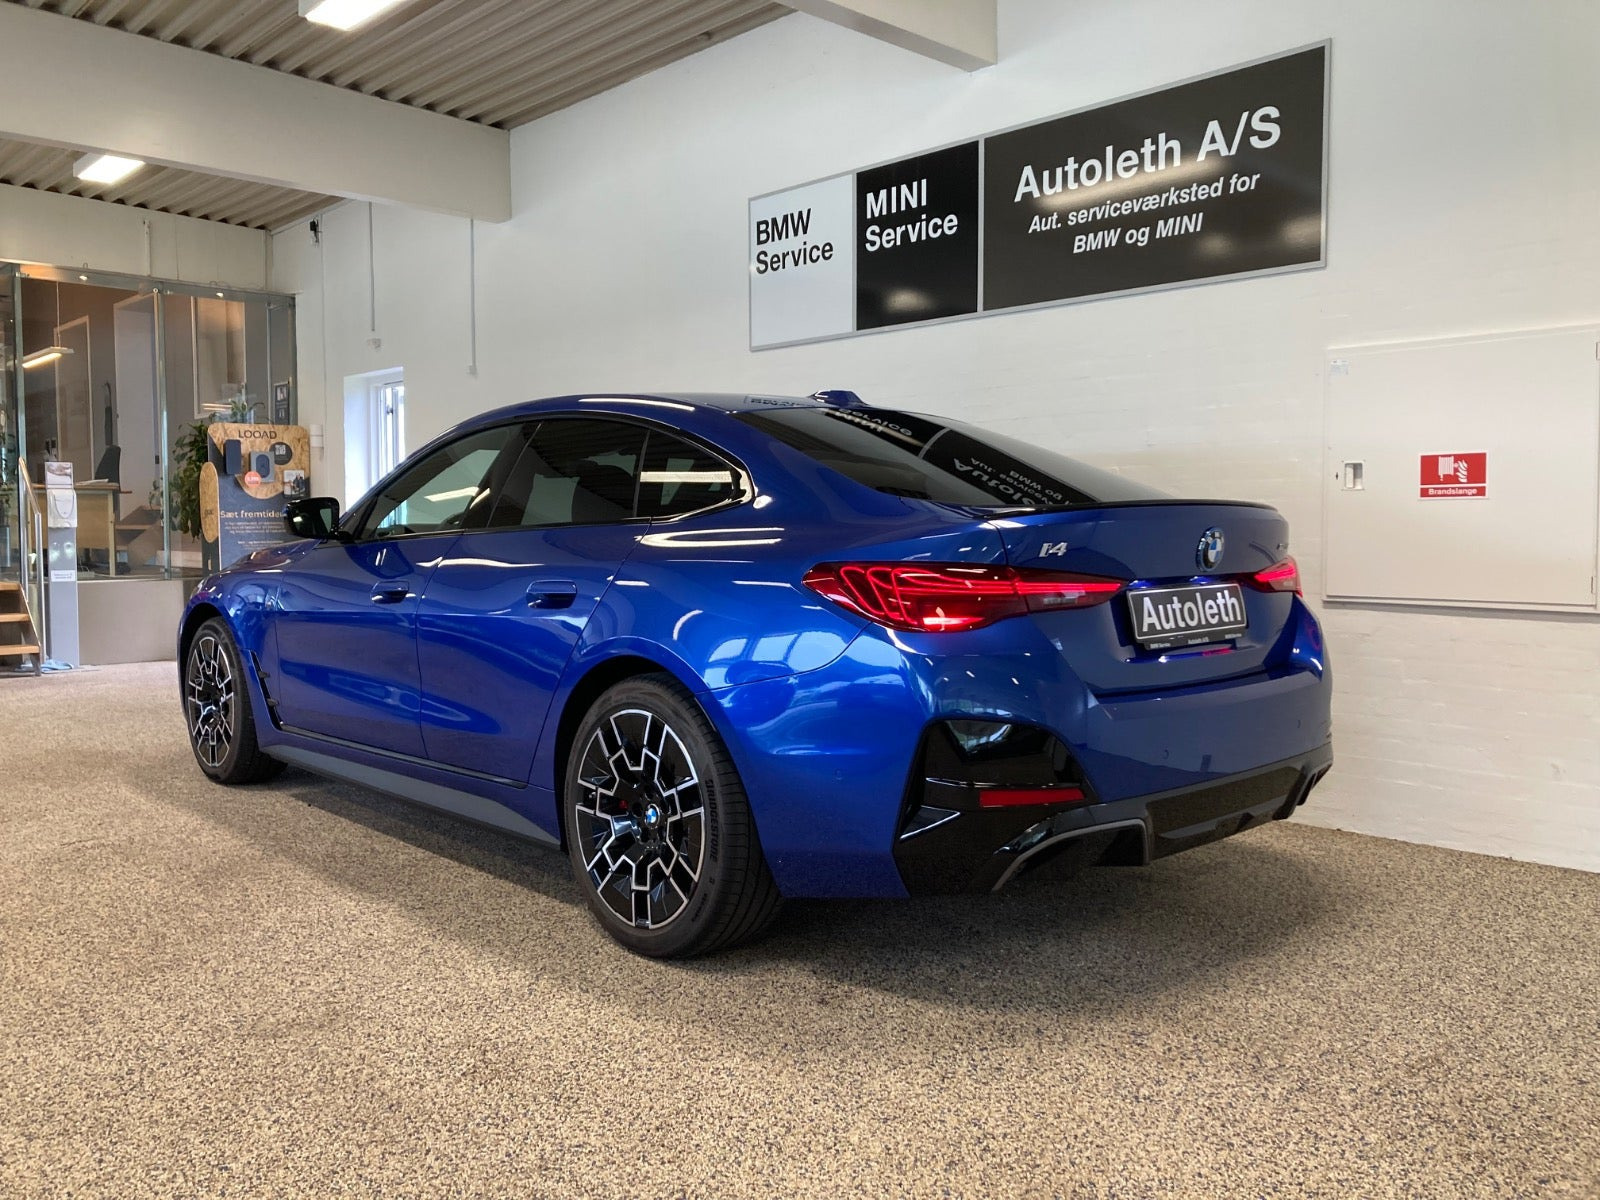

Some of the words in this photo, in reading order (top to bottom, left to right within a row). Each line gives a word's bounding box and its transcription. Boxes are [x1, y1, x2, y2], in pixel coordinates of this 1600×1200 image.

[1014, 132, 1181, 203] Autoleth
[1196, 105, 1281, 162] A/S
[866, 178, 928, 219] MINI
[1028, 215, 1062, 234] Aut.
[1067, 176, 1223, 226] serviceværksted
[1228, 173, 1261, 194] for
[756, 208, 812, 246] BMW
[865, 213, 959, 252] Service
[1073, 228, 1121, 254] BMW
[1125, 226, 1150, 247] og
[1155, 212, 1204, 239] MINI
[756, 241, 834, 275] Service
[238, 430, 278, 440] LOOAD
[1428, 487, 1478, 496] Brandslange
[1038, 541, 1068, 558] i4
[1142, 589, 1242, 632] Autoleth
